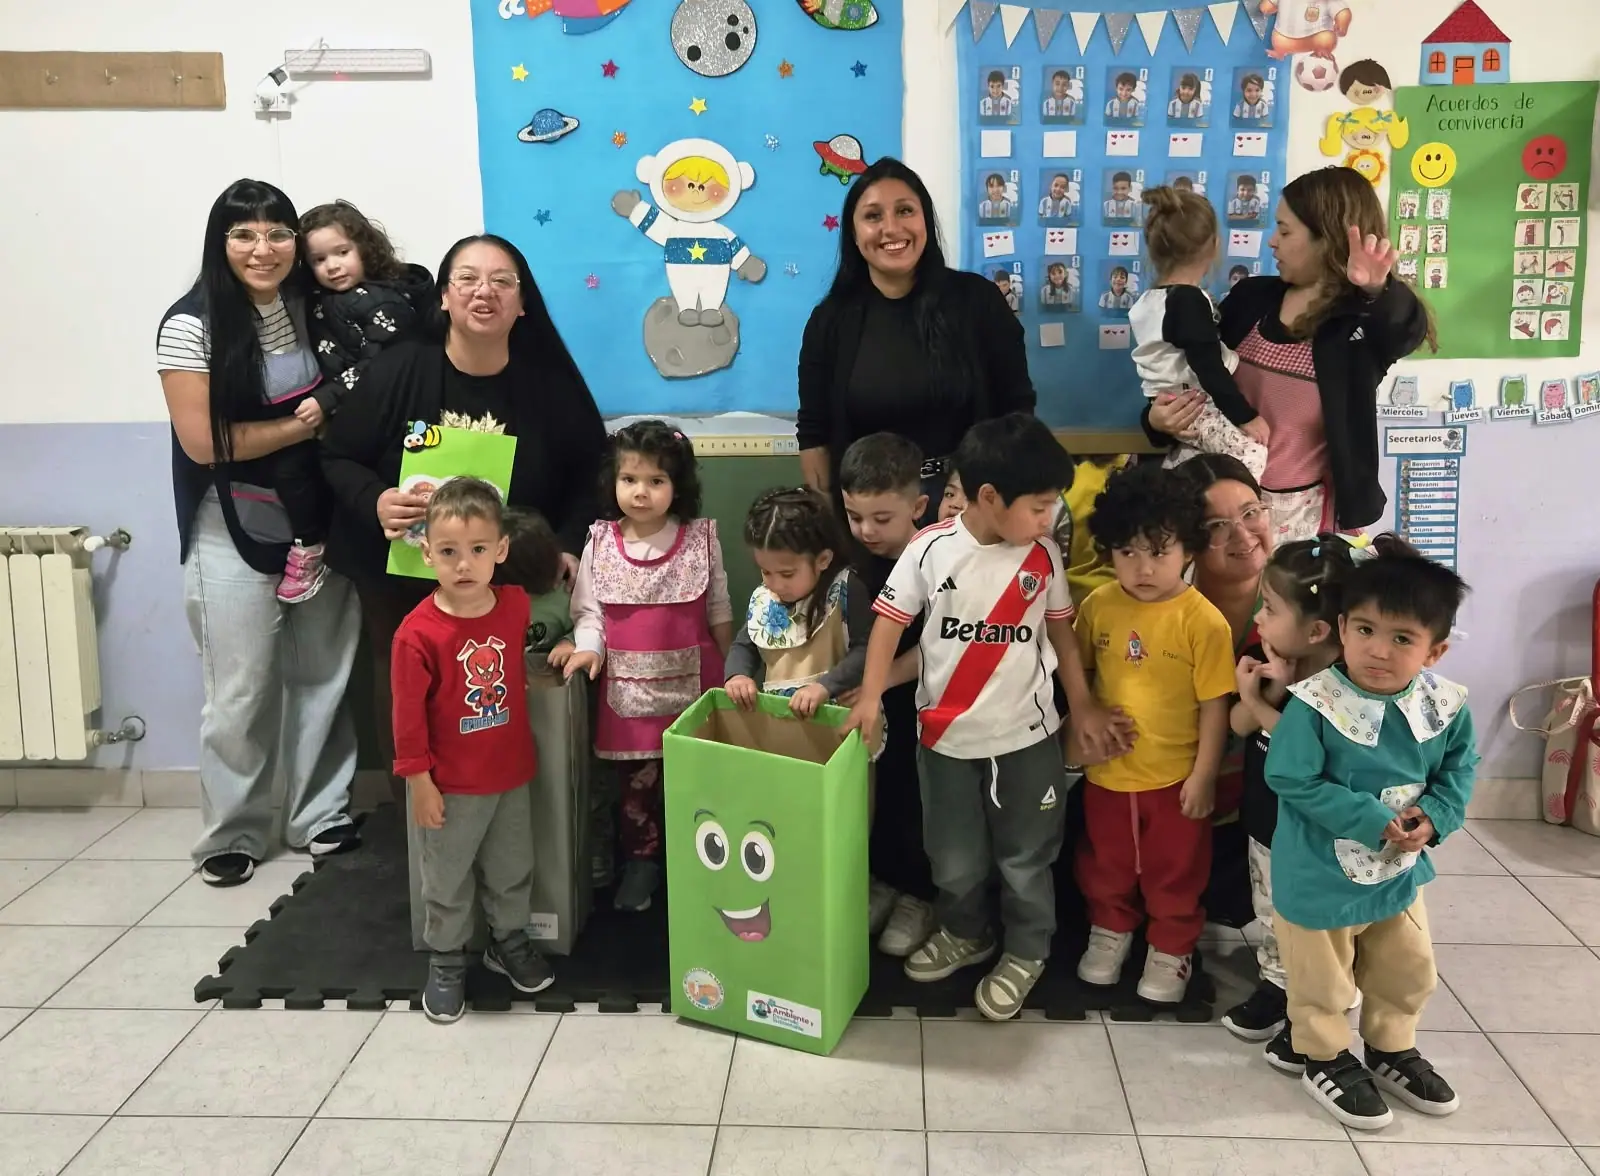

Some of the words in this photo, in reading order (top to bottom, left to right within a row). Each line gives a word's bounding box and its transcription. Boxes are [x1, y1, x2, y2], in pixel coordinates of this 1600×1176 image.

[1426, 94, 1499, 112] Acuerdos
[1514, 92, 1535, 110] de
[1438, 114, 1524, 131] convivencia
[1451, 411, 1479, 421] Jueves
[1497, 408, 1530, 416] Viernes
[1388, 435, 1442, 443] Secretarios
[940, 616, 1033, 643] Betano
[773, 1008, 810, 1025] Ambiente
